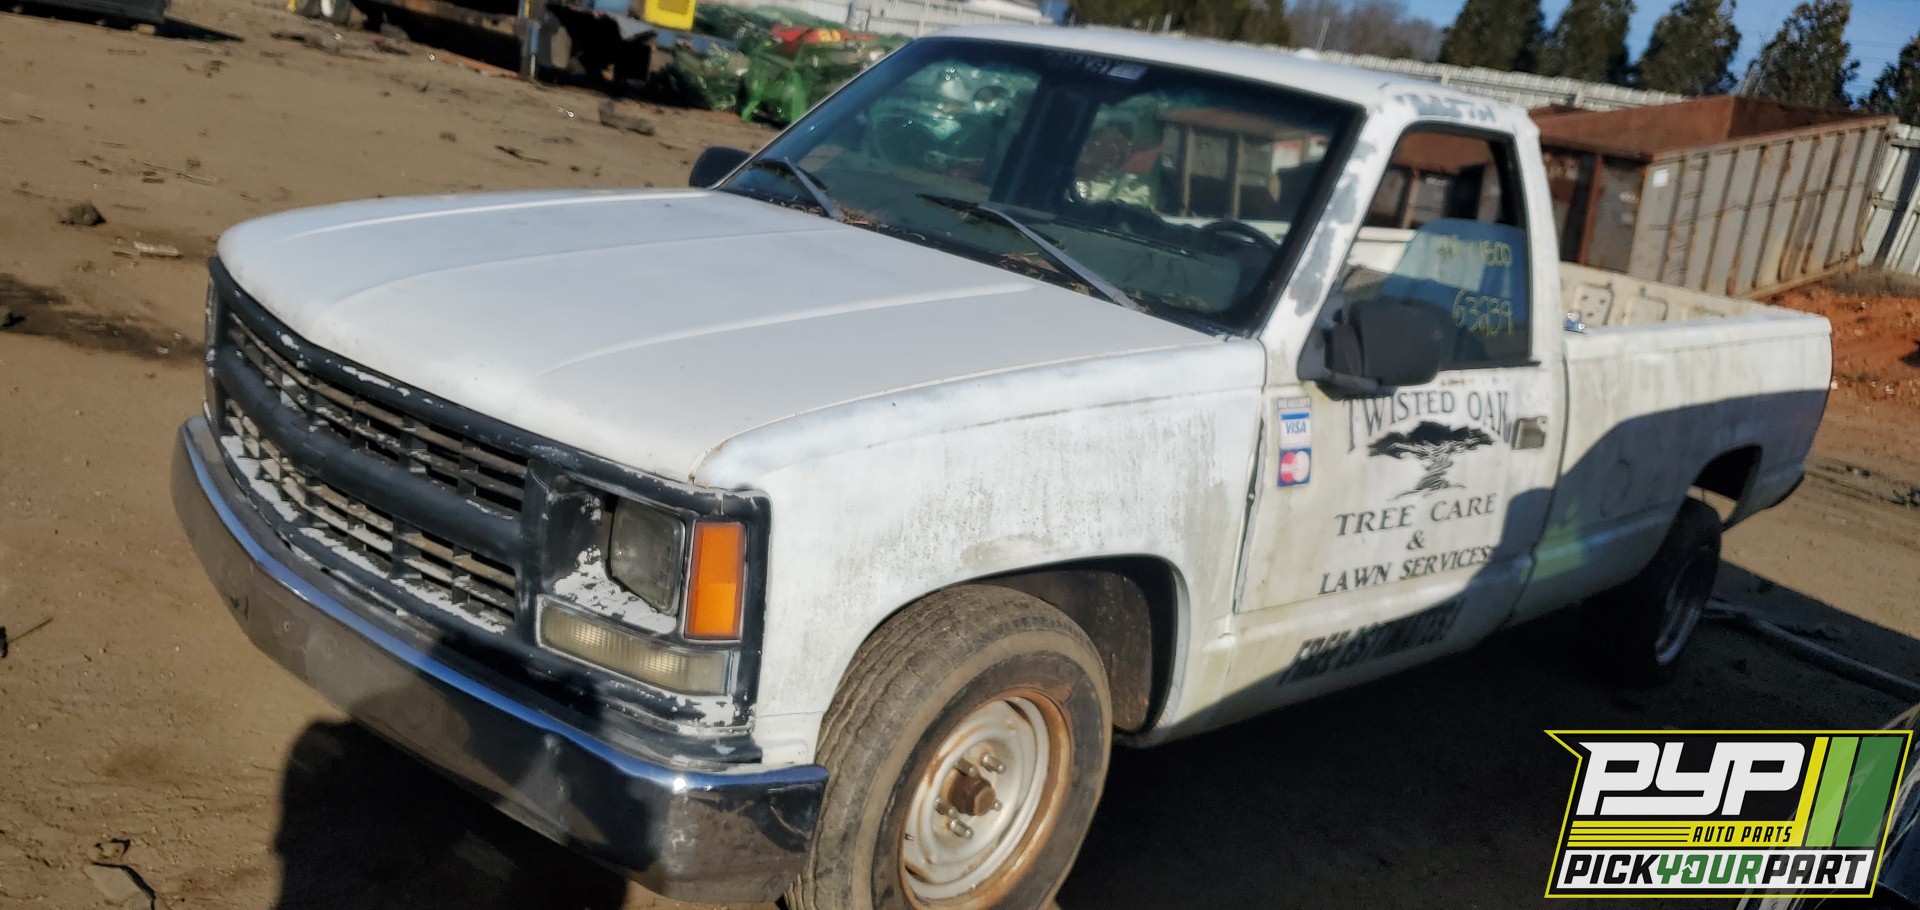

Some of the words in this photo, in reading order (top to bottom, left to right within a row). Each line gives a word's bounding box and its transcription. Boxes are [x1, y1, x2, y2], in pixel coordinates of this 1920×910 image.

[1286, 421, 1306, 434] VISA
[1343, 390, 1454, 454] TWISTED
[1335, 504, 1414, 536] TREE
[1430, 493, 1496, 522] CARE
[1406, 530, 1425, 550] &
[1318, 562, 1391, 595] LAWN
[1400, 545, 1495, 580] SERVICES
